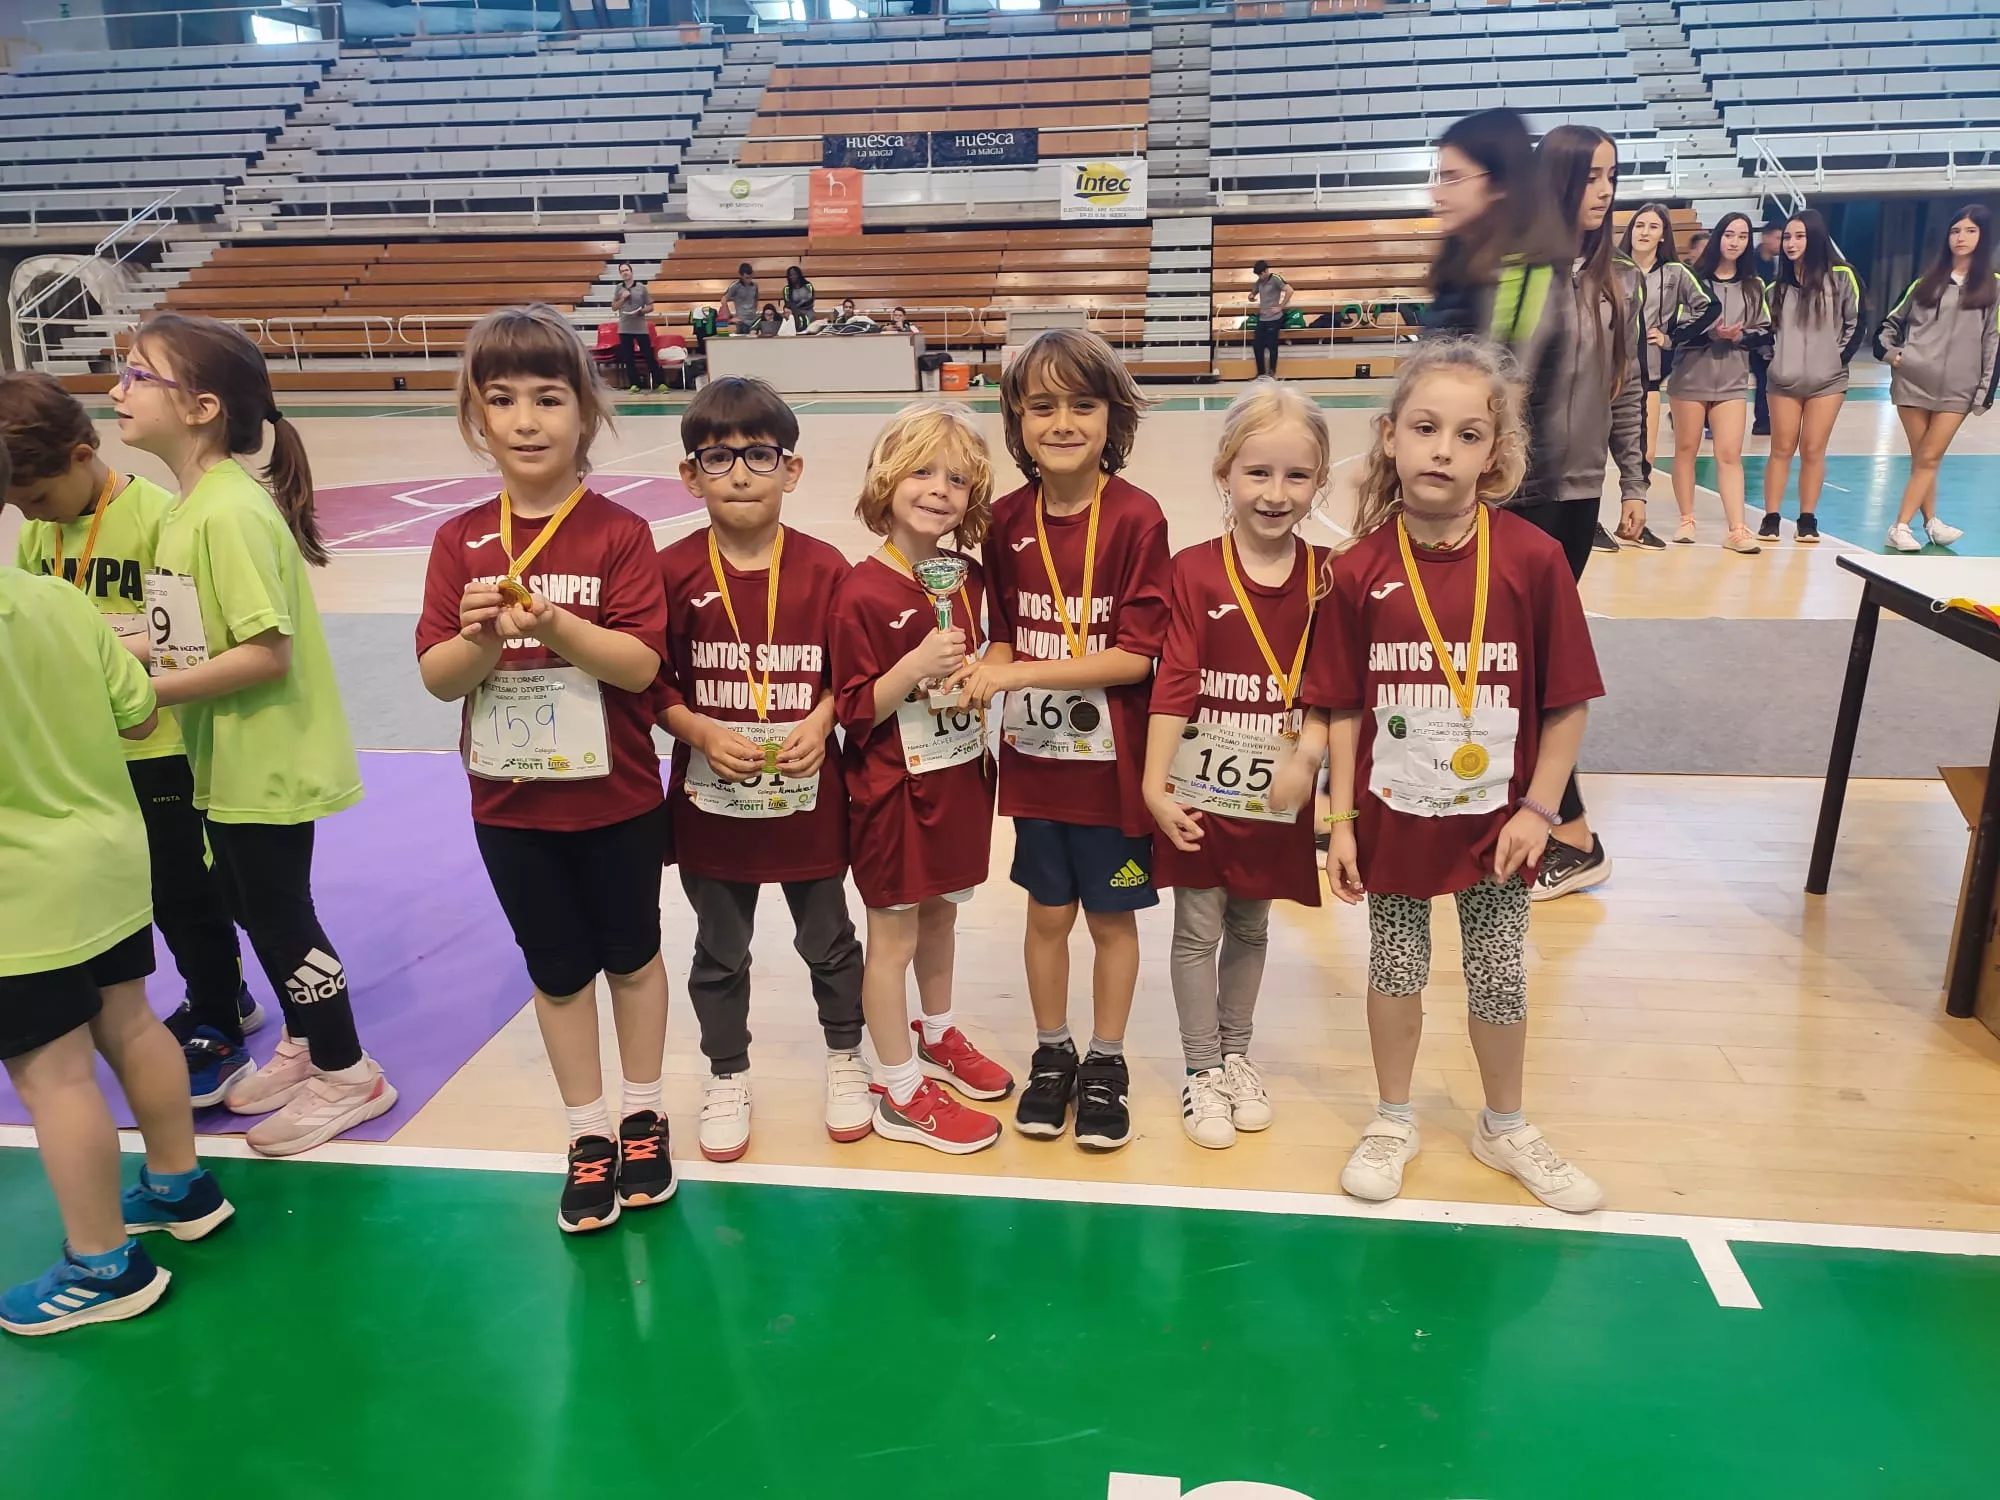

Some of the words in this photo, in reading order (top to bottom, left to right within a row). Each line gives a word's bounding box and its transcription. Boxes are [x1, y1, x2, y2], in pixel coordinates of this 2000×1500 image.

[756, 643, 823, 672] SAMPER
[1368, 641, 1433, 672] SANTOS
[512, 675, 545, 684] TORNEO
[488, 703, 557, 748] 159
[1201, 732, 1240, 746] ATLETISMO
[1242, 742, 1281, 752] DIVERTIDO
[1195, 748, 1275, 792] 165
[1433, 758, 1453, 771] 16
[152, 795, 181, 803] KIPSTA
